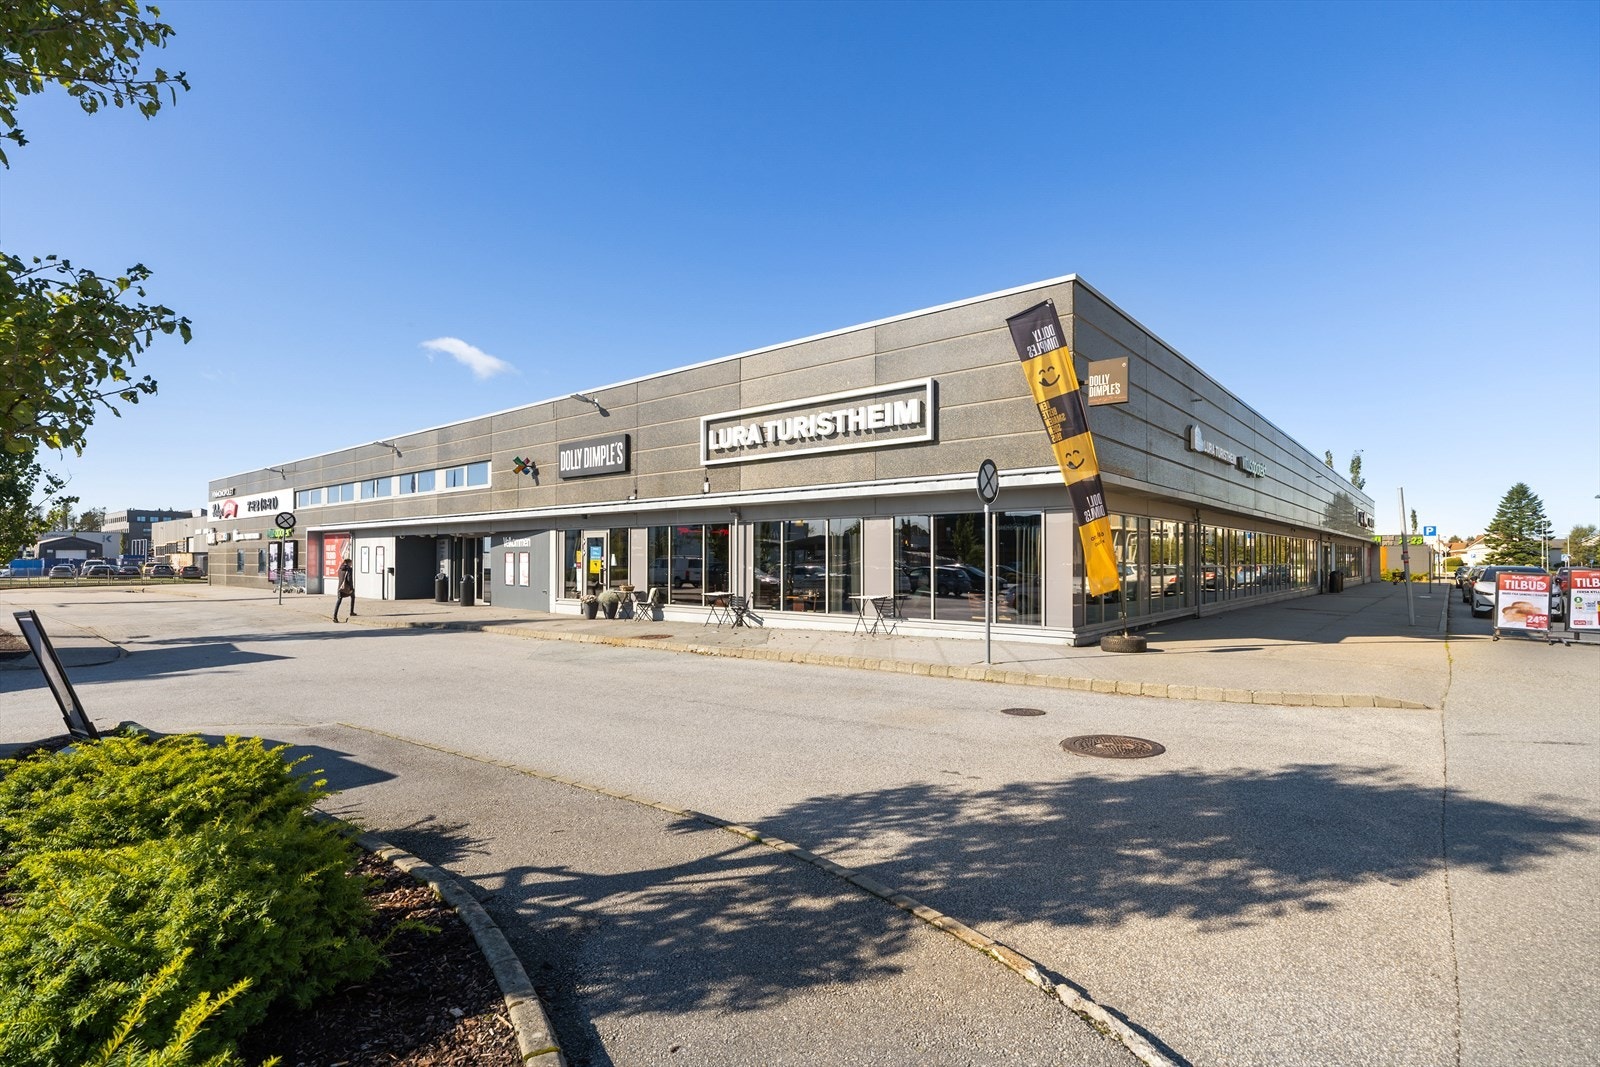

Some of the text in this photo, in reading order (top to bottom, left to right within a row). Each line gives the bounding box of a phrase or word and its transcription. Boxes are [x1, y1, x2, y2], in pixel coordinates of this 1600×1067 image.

[1089, 374, 1110, 387] DOLLY
[709, 398, 921, 450] LURA TURISTHEIM
[560, 441, 623, 471] DOLLY DIMPLE'S
[503, 536, 531, 547] Velkommen
[1504, 580, 1547, 591] TILBUD
